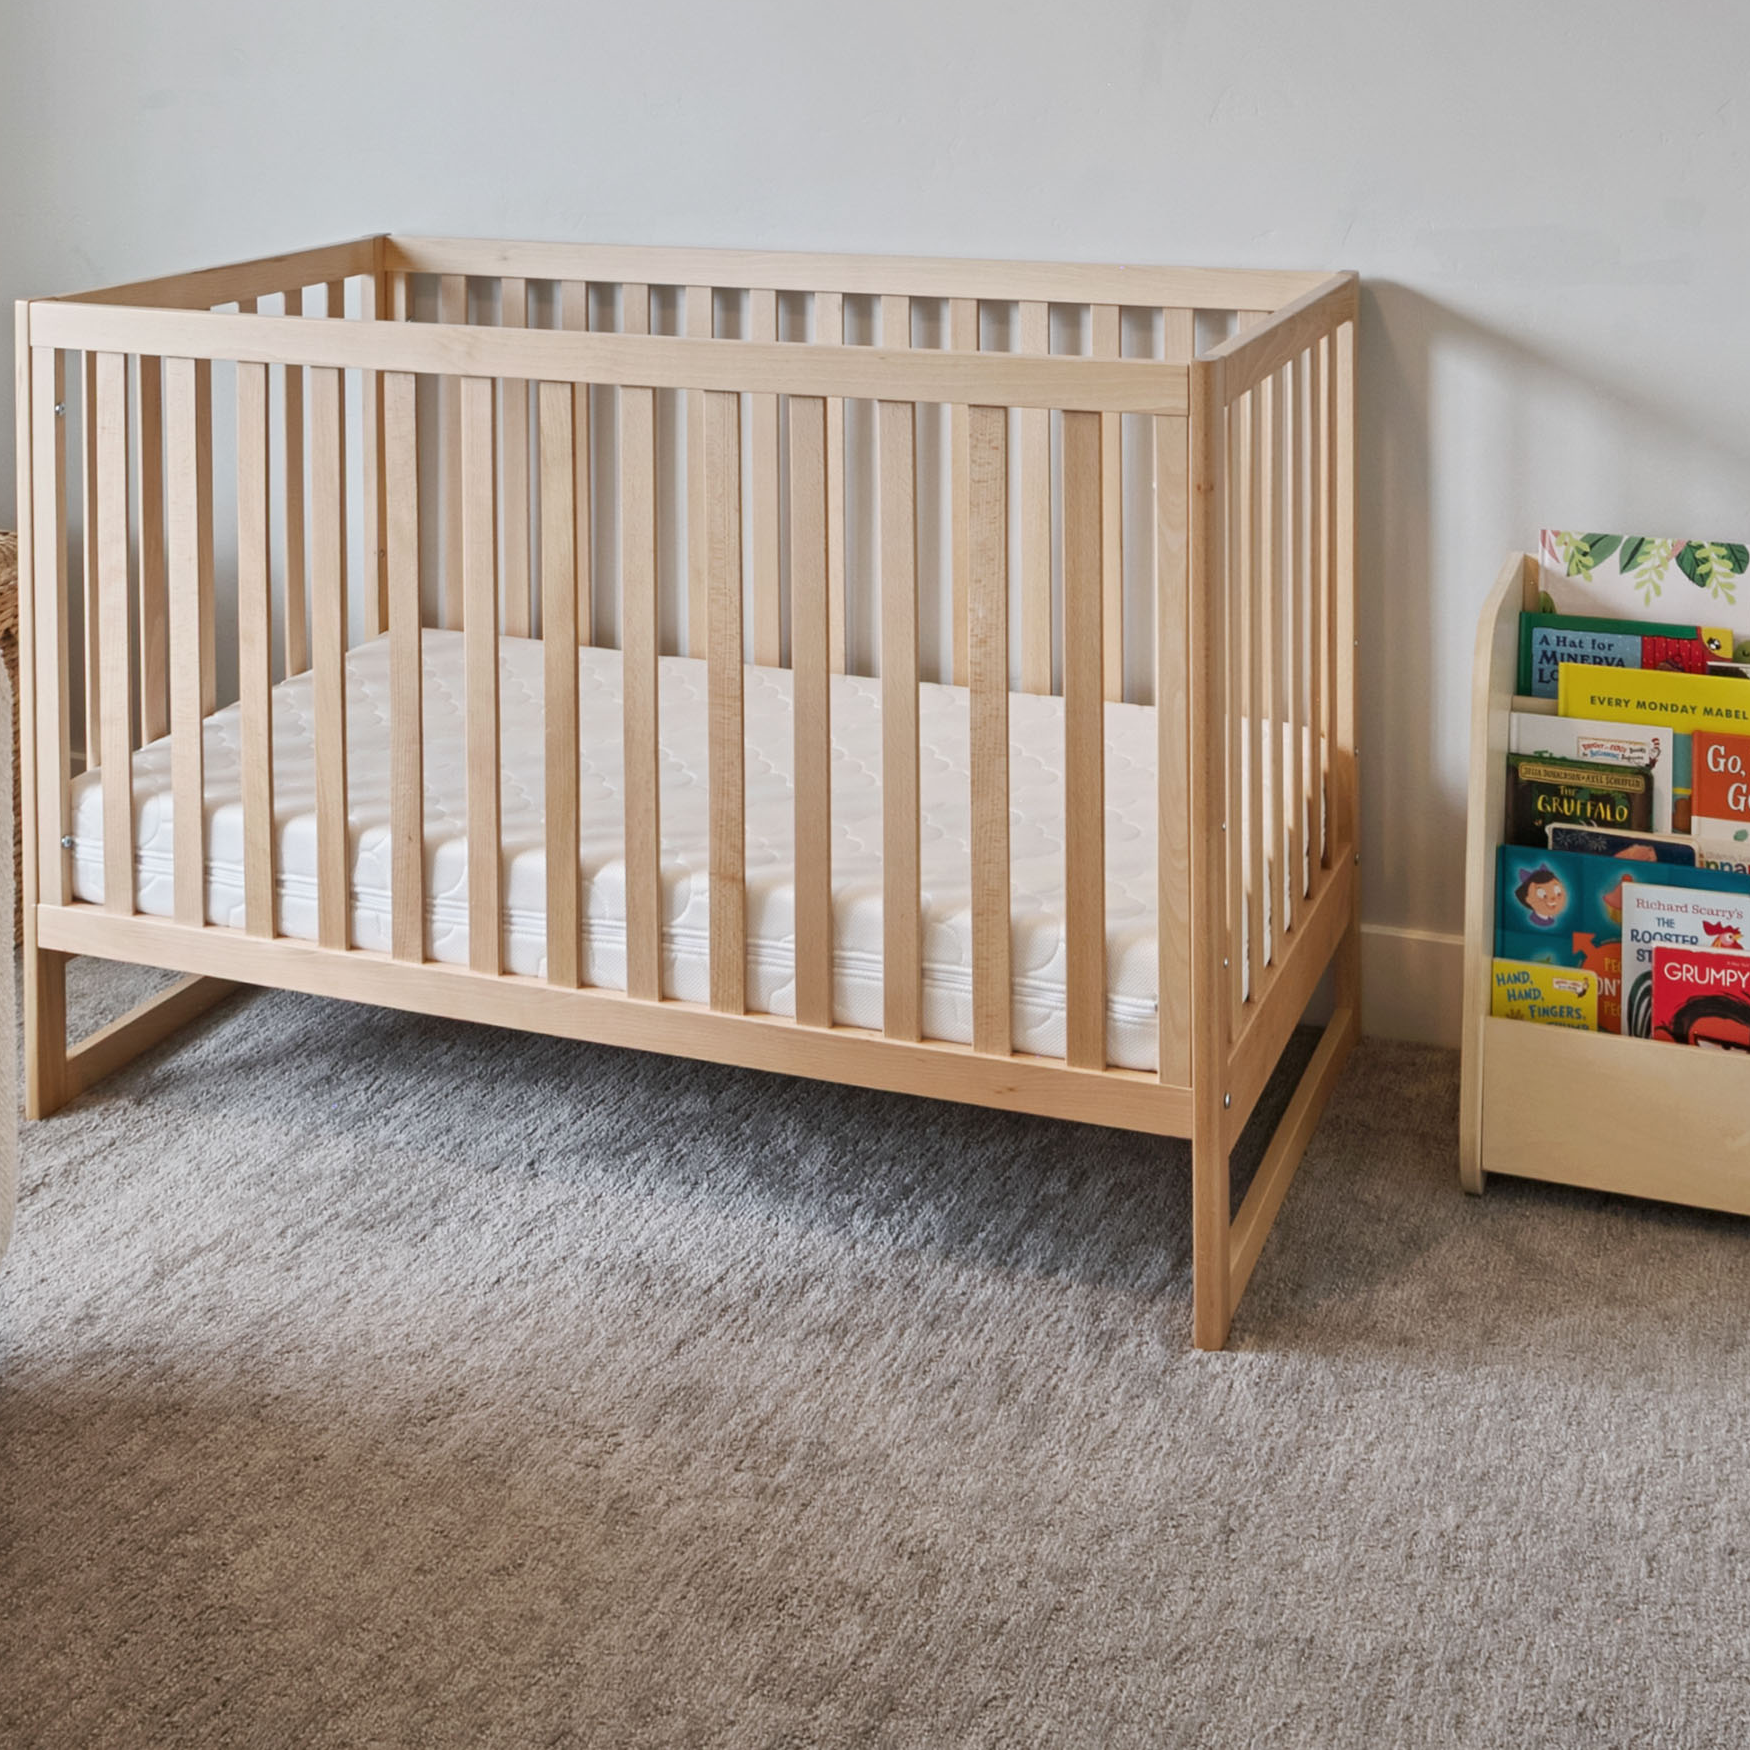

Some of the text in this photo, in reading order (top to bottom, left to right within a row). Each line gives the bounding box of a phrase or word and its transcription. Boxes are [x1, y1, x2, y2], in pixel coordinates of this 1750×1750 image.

[1539, 634, 1614, 651] A Hat for
[1590, 695, 1749, 720] EVERY MONDAY MABEL
[1707, 744, 1746, 777] Go,
[1537, 794, 1628, 822] GRUFFALO
[1636, 898, 1744, 920] Richard Scarry's
[1656, 917, 1675, 929] THE
[1496, 971, 1534, 987] HAND,
[1664, 961, 1750, 988] GRUMPY
[1507, 988, 1545, 1001] HAND,
